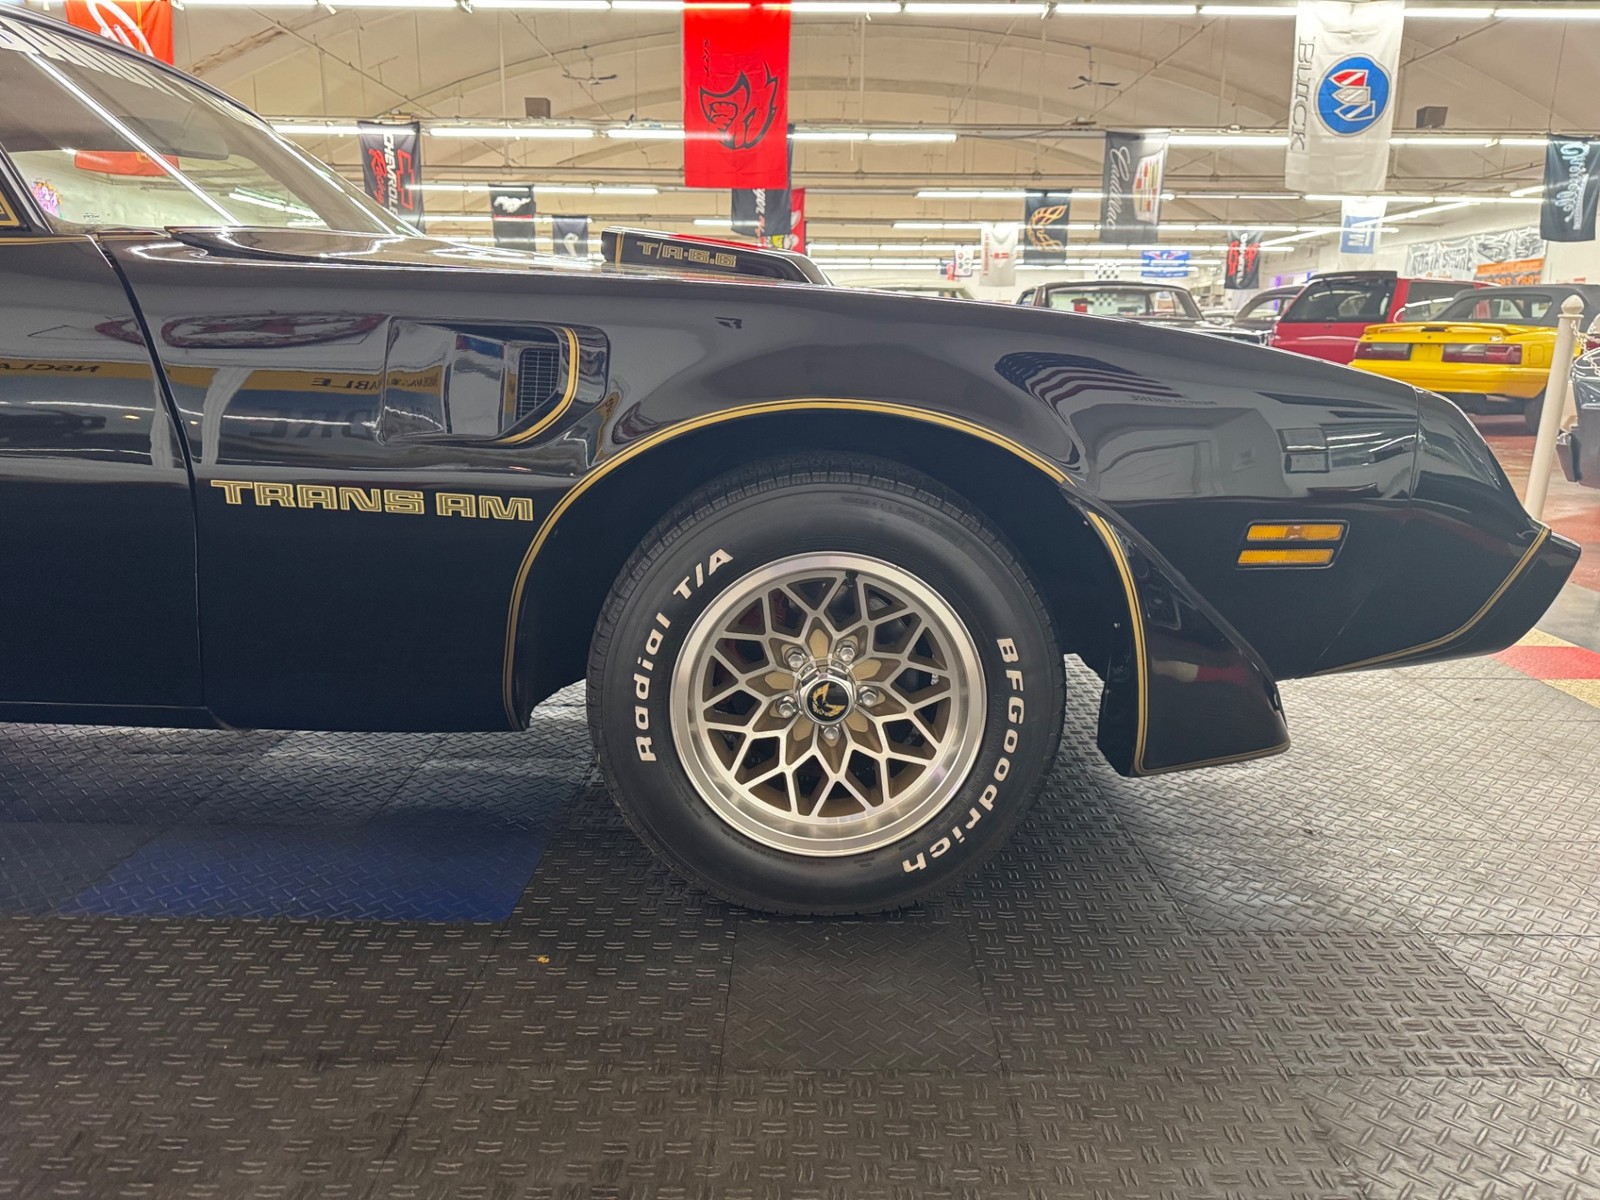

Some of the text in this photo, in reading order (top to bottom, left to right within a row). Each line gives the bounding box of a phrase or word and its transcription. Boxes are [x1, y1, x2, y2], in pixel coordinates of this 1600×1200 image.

[1290, 37, 1315, 150] BUICK
[383, 133, 398, 216] CHEVROLE
[1105, 146, 1130, 231] Cadillac
[210, 479, 535, 522] TRANS AM
[633, 548, 734, 762] Radial T/A
[901, 637, 1025, 873] BFGoodrich
